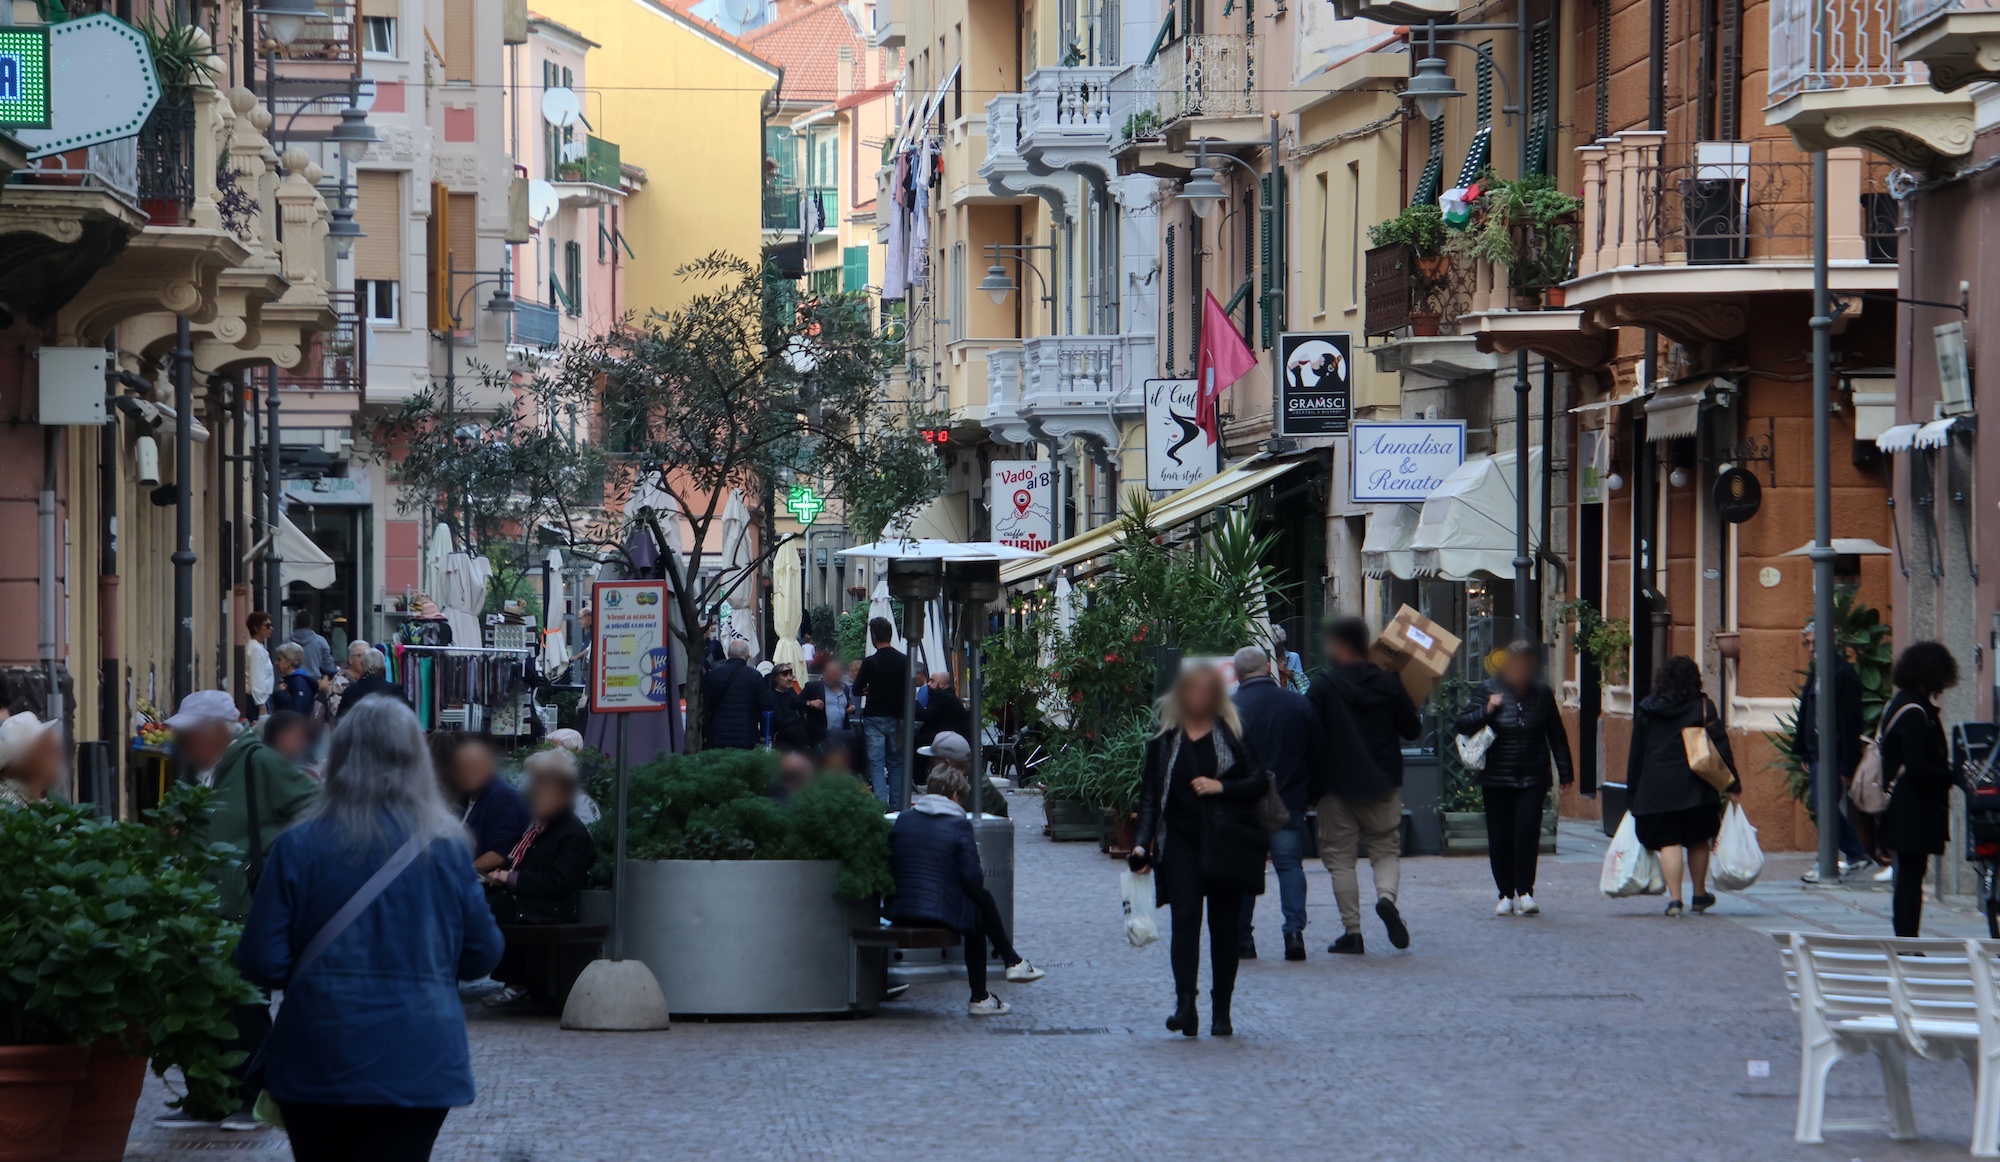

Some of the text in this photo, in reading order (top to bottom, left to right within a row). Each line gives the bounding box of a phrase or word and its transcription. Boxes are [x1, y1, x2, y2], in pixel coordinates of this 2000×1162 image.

[1150, 385, 1163, 406] il
[1289, 397, 1345, 409] GRAMSCI
[1359, 433, 1456, 455] Annalisa
[1399, 456, 1418, 474] &
[1027, 477, 1037, 490] al
[1160, 466, 1203, 484] hair style
[1368, 468, 1443, 491] Renato
